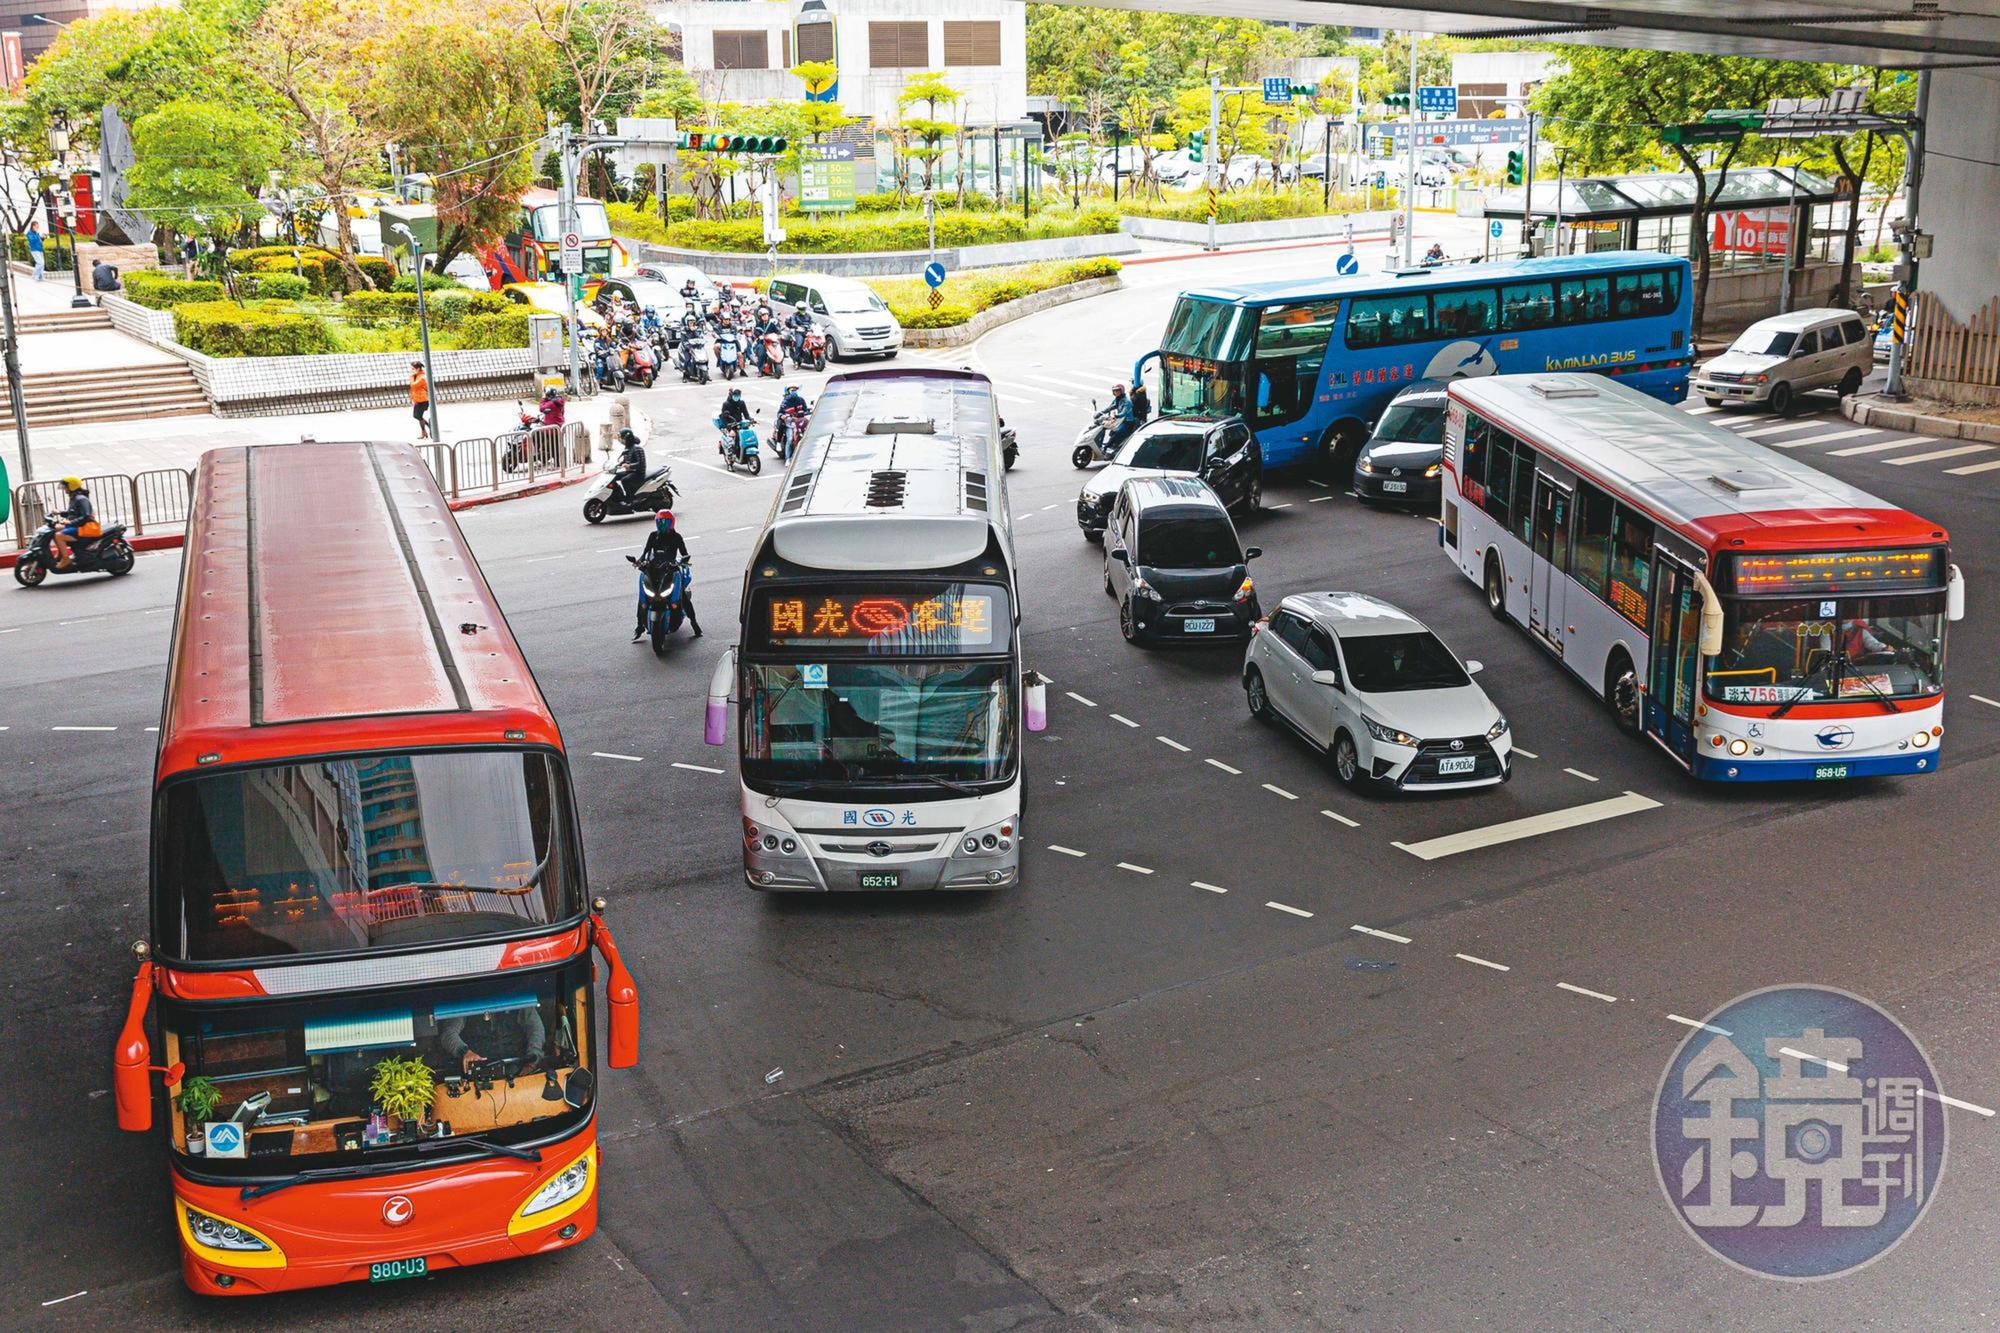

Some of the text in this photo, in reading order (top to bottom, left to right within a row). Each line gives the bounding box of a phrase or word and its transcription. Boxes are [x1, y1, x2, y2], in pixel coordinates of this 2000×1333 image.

[1611, 350, 1636, 363] BUS
[772, 598, 849, 634] 國光
[1816, 766, 1847, 778] 968-U5
[843, 809, 917, 825] 國 光
[862, 876, 898, 887] 652-FW
[372, 1257, 425, 1279] 980-U3
